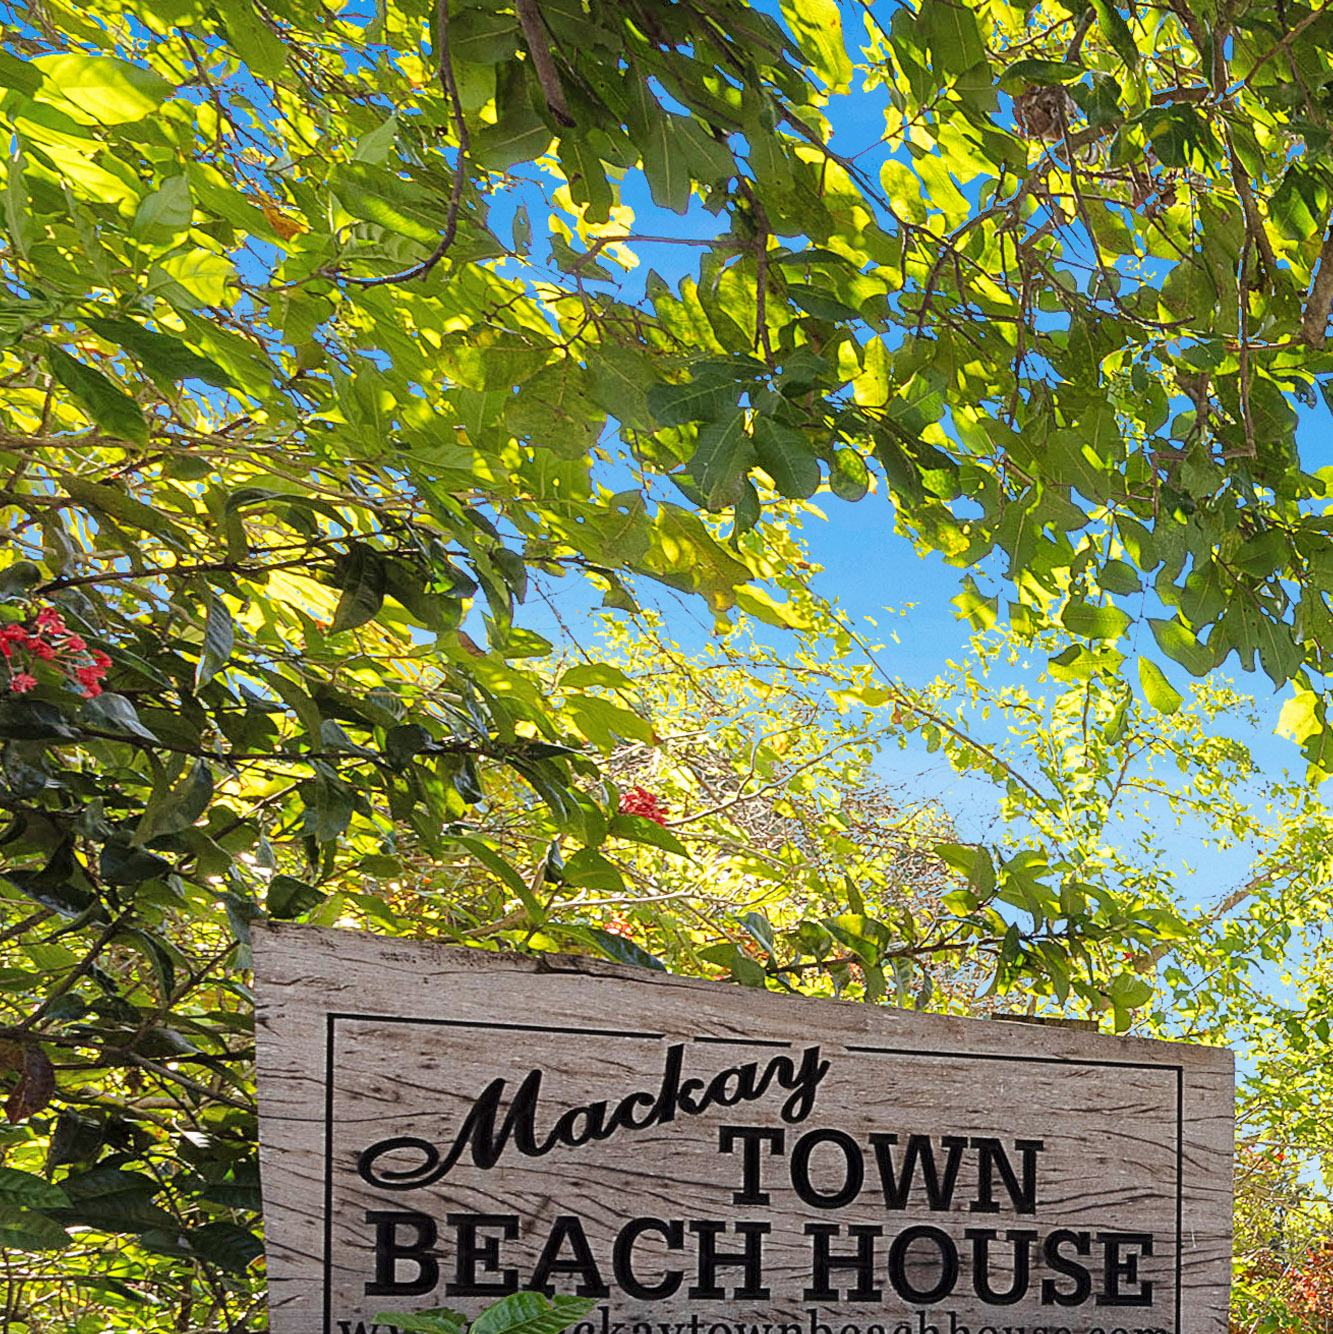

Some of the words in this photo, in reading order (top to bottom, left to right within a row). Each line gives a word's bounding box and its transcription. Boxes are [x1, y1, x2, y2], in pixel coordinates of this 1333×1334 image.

[357, 1042, 831, 1191] Mackay
[718, 1125, 1044, 1215] TOWN
[364, 1210, 771, 1300] BEACH
[803, 1222, 1153, 1307] HOUSE
